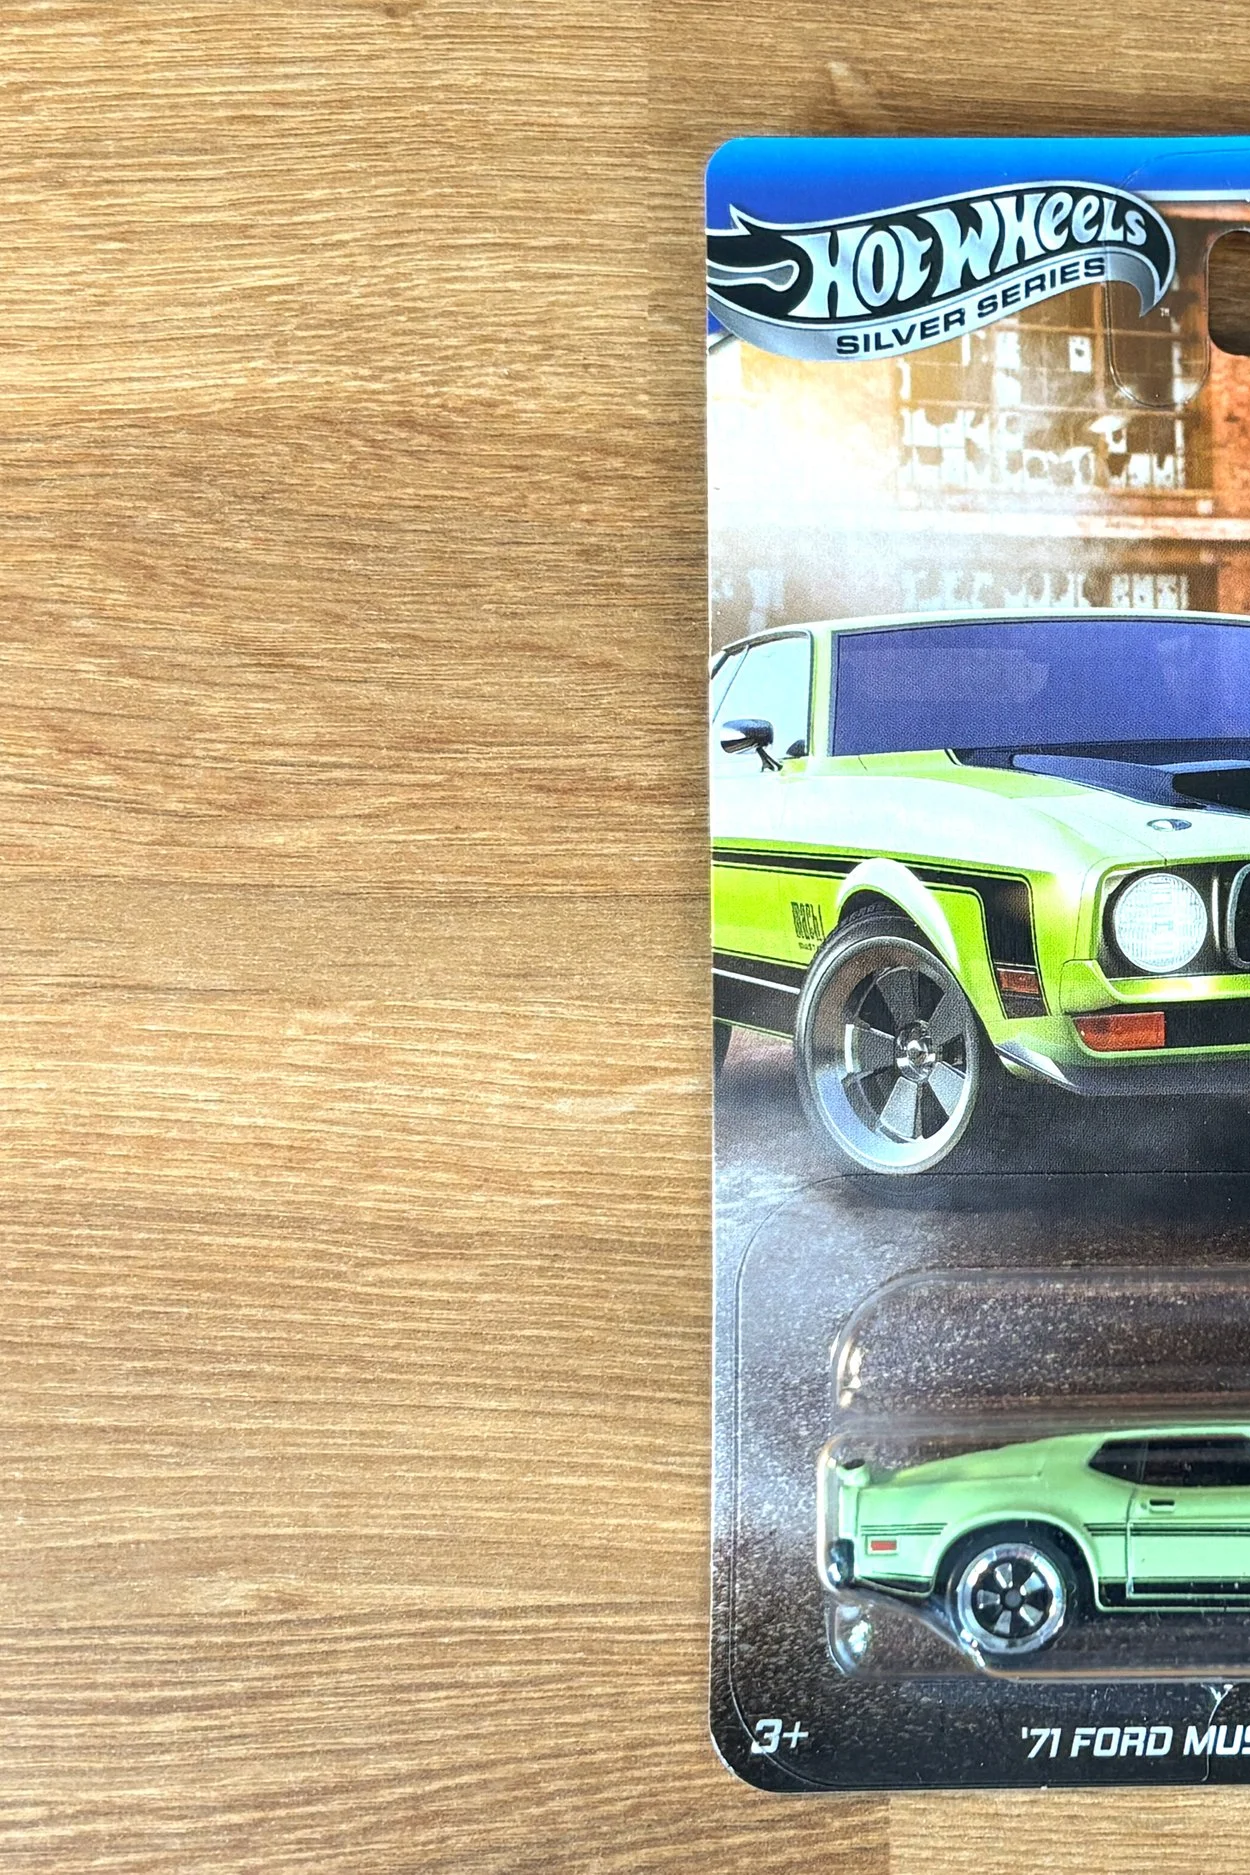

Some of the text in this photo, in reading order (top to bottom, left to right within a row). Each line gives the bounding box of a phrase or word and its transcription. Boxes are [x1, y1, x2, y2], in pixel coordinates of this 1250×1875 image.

[836, 257, 1107, 356] SILVER SERIES
[751, 1718, 809, 1754] 3+
[1021, 1727, 1061, 1758] '71
[1070, 1726, 1172, 1757] FORD
